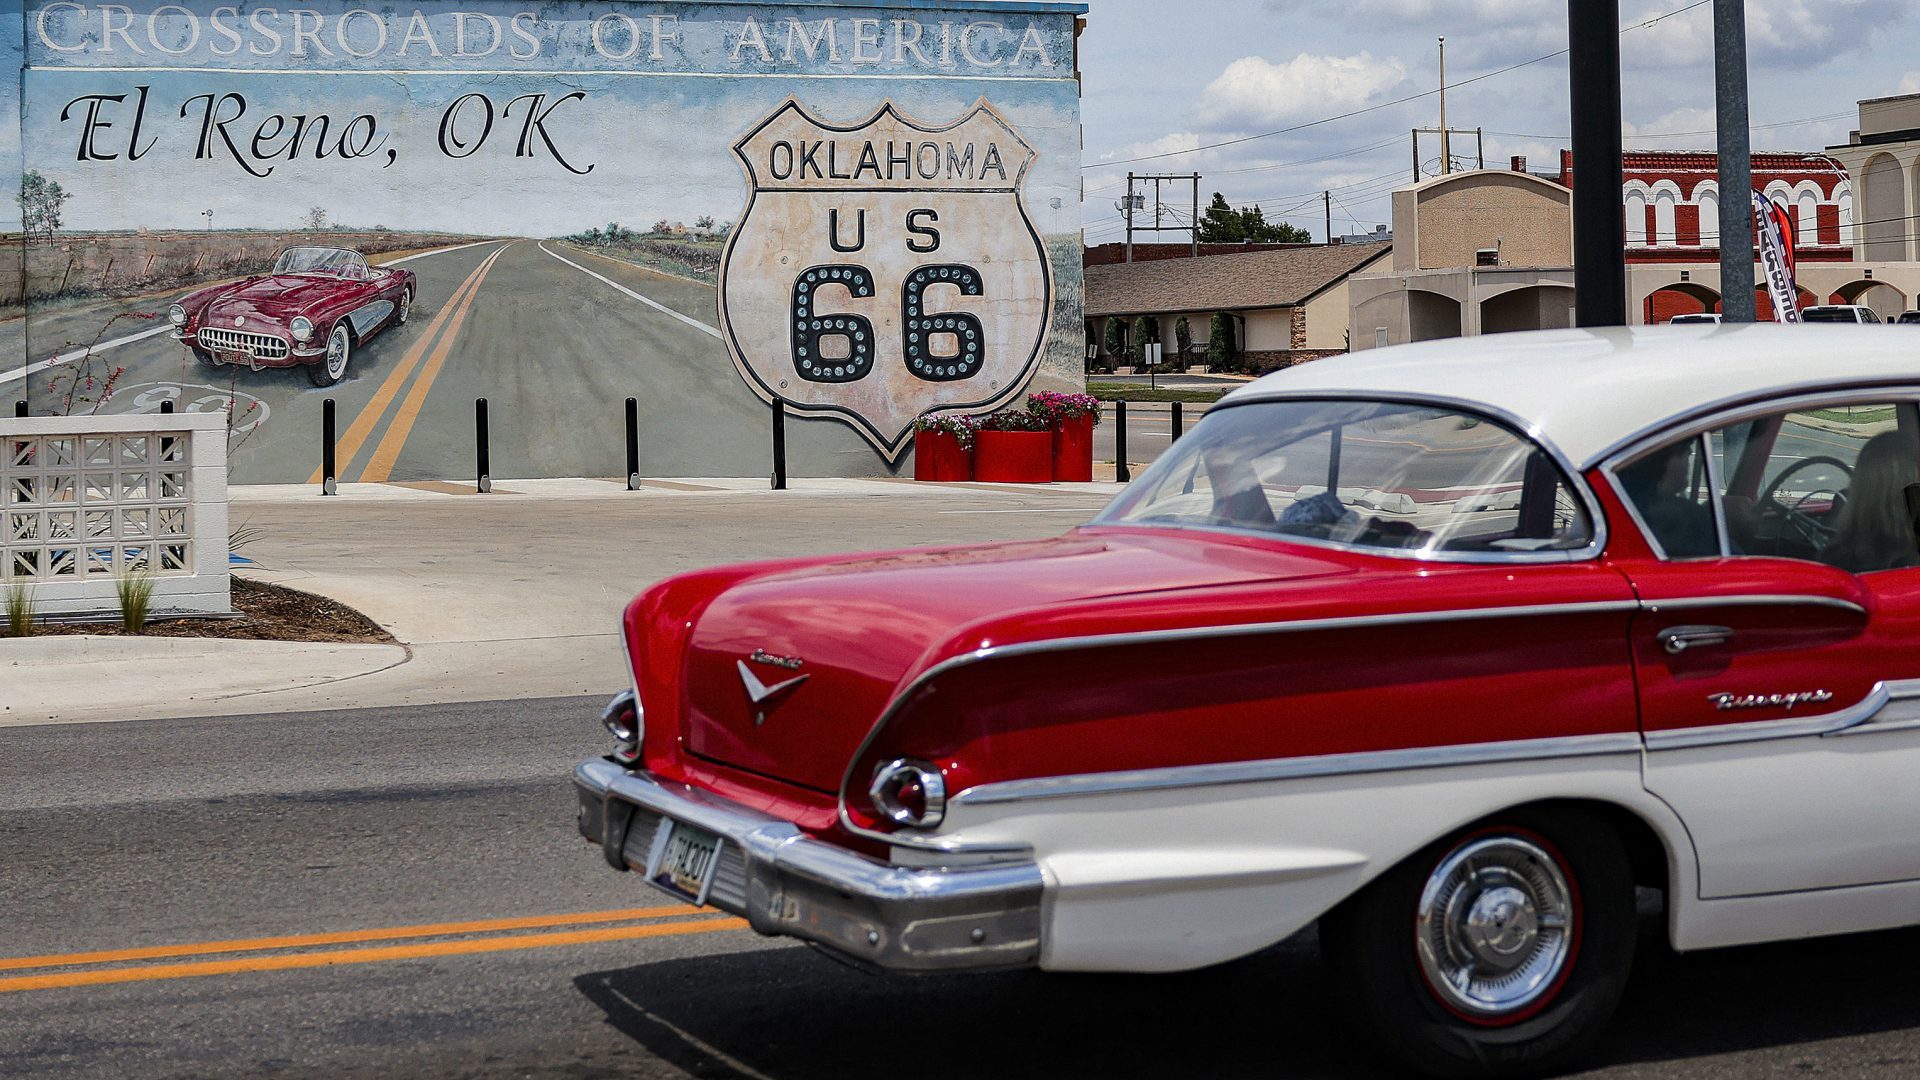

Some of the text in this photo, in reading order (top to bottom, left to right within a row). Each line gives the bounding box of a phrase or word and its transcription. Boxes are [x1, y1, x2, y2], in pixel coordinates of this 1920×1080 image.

[36, 1, 1056, 68] CROSSROADS OF AMERICA
[60, 86, 595, 178] El Reno, OK
[769, 140, 1008, 181] OKLAHOMA
